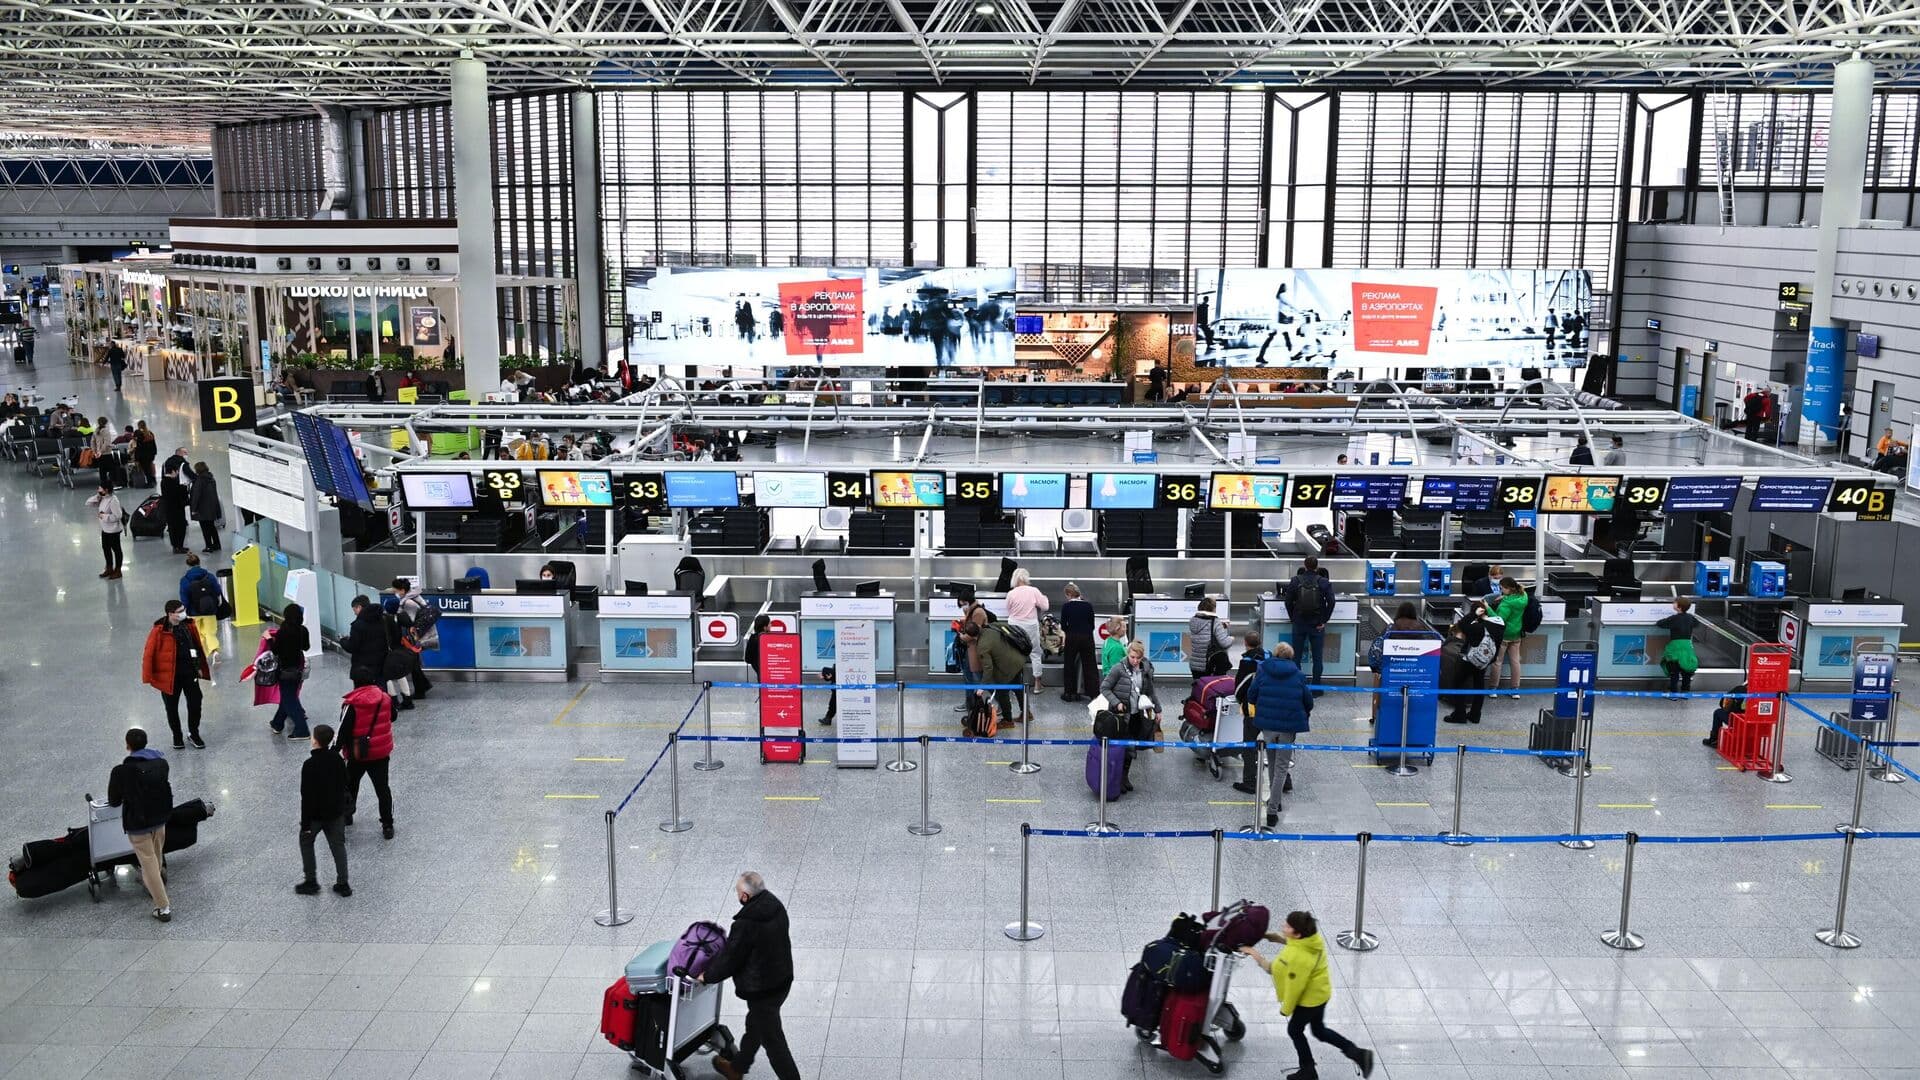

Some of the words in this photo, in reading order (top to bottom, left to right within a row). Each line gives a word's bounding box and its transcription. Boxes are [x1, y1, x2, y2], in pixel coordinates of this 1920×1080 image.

[815, 291, 855, 300] РЕКЛАМА
[1362, 292, 1400, 300] РЕКЛАМА
[1782, 286, 1796, 296] 32
[791, 303, 797, 311] В
[799, 303, 856, 311] АЭРОПОРТАХ
[1361, 303, 1368, 311] В
[1813, 340, 1836, 349] Track
[213, 387, 241, 424] B
[488, 472, 520, 488] 33
[499, 488, 513, 499] B
[629, 481, 659, 499] 33
[832, 481, 862, 499] 34
[961, 481, 990, 499] 35
[1166, 483, 1196, 501] 36
[1297, 484, 1326, 501] 37
[1503, 486, 1533, 503] 38
[1628, 486, 1658, 503] 39
[1837, 488, 1868, 505] 40
[1868, 491, 1885, 512] B
[438, 598, 469, 610] Utair
